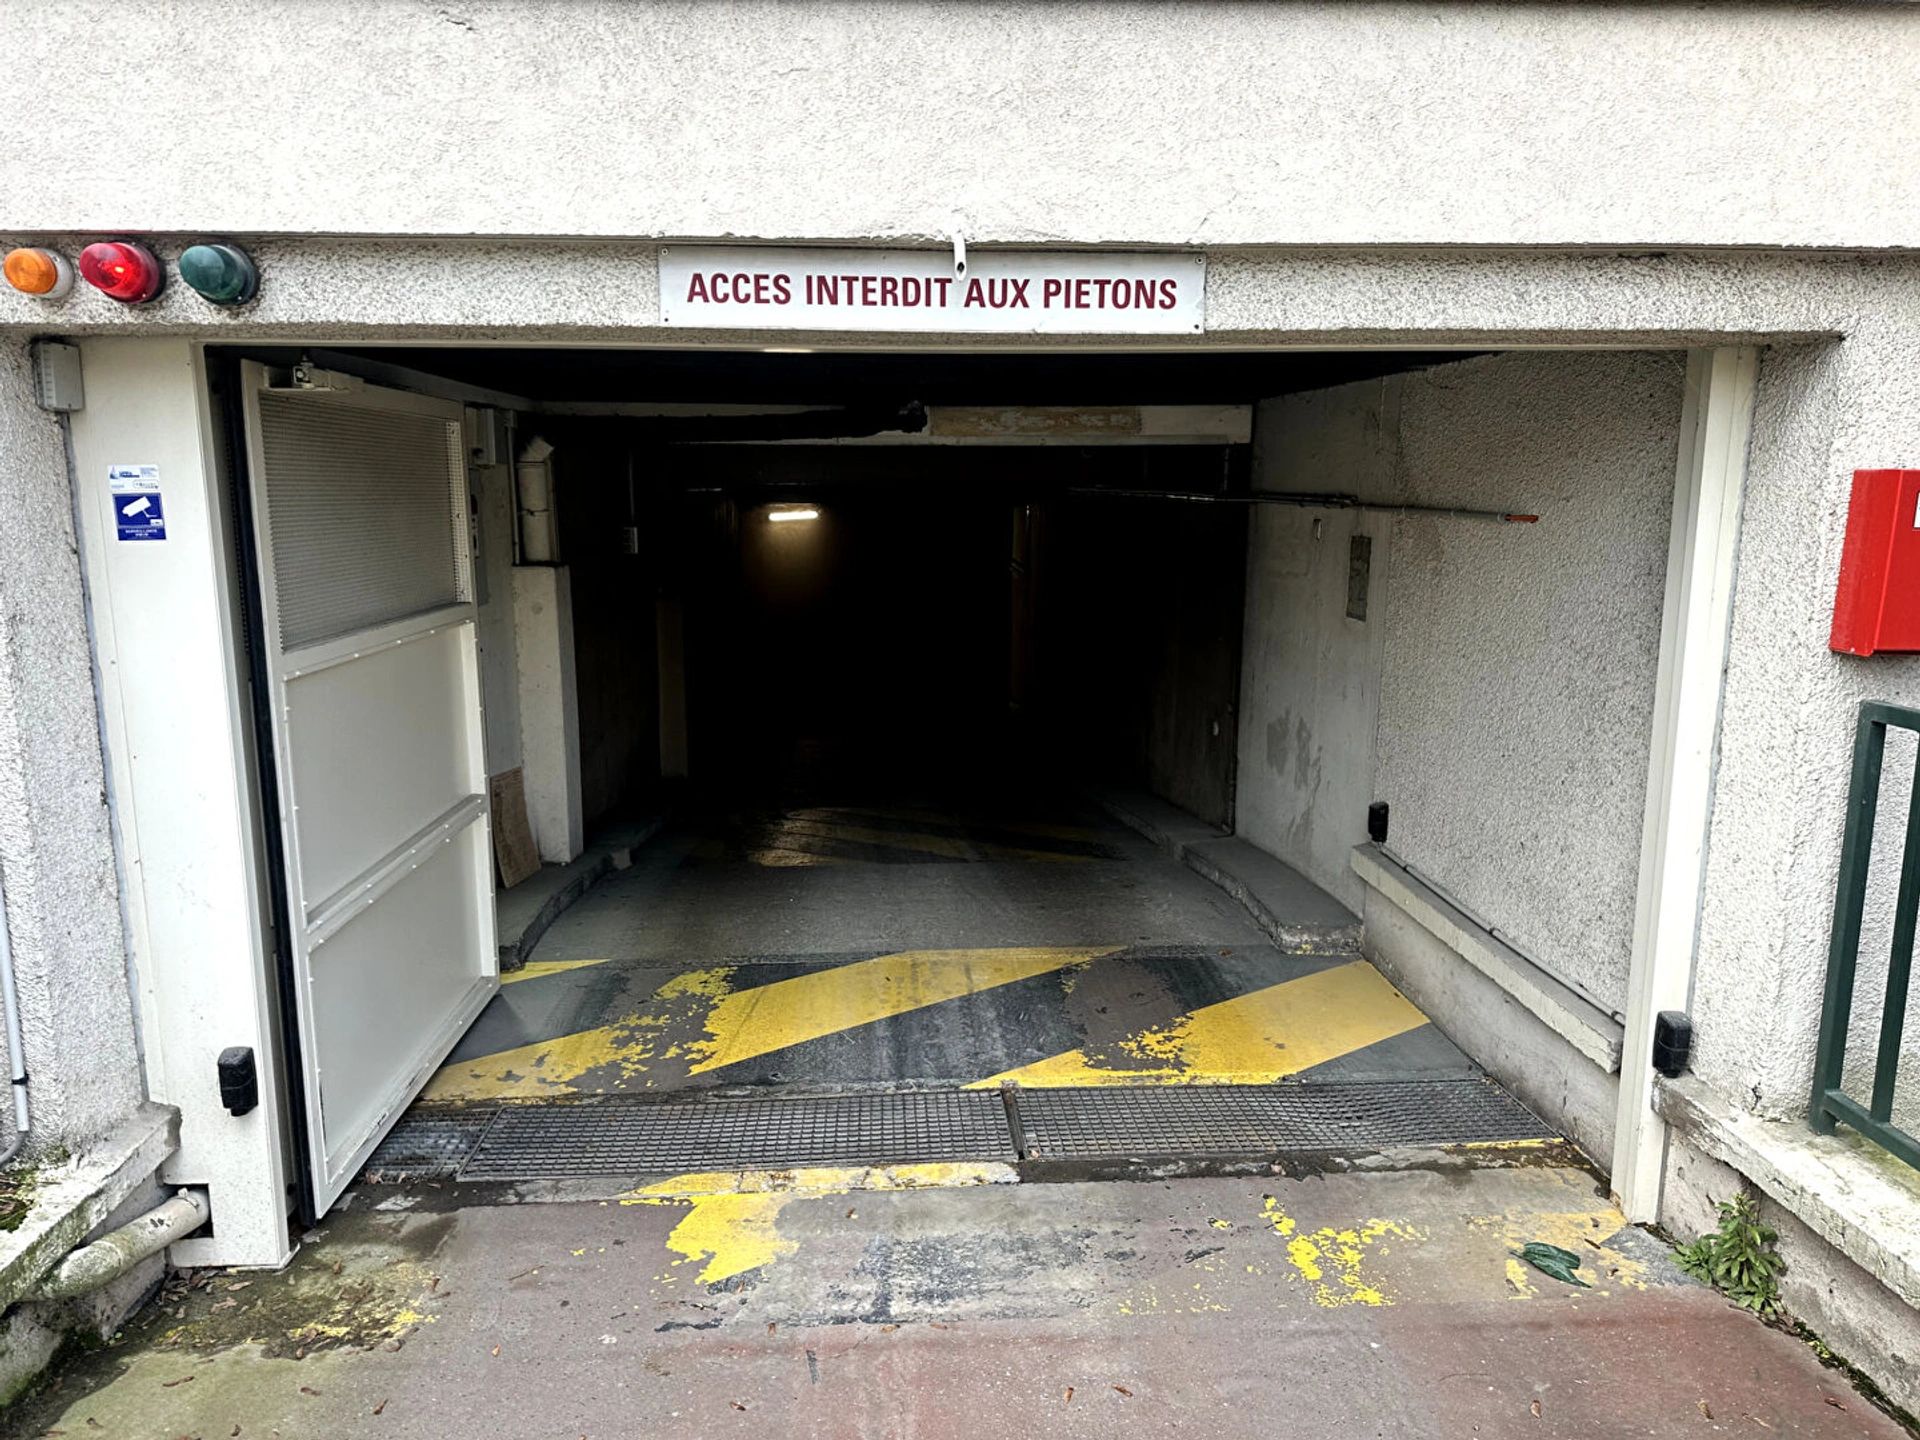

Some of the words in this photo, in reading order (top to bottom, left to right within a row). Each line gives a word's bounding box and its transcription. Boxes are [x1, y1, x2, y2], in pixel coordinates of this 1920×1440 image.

[687, 273, 791, 305] ACCES
[806, 275, 951, 307] INTERDIT
[964, 278, 1029, 308] AUX
[1043, 279, 1177, 310] PIETONS
